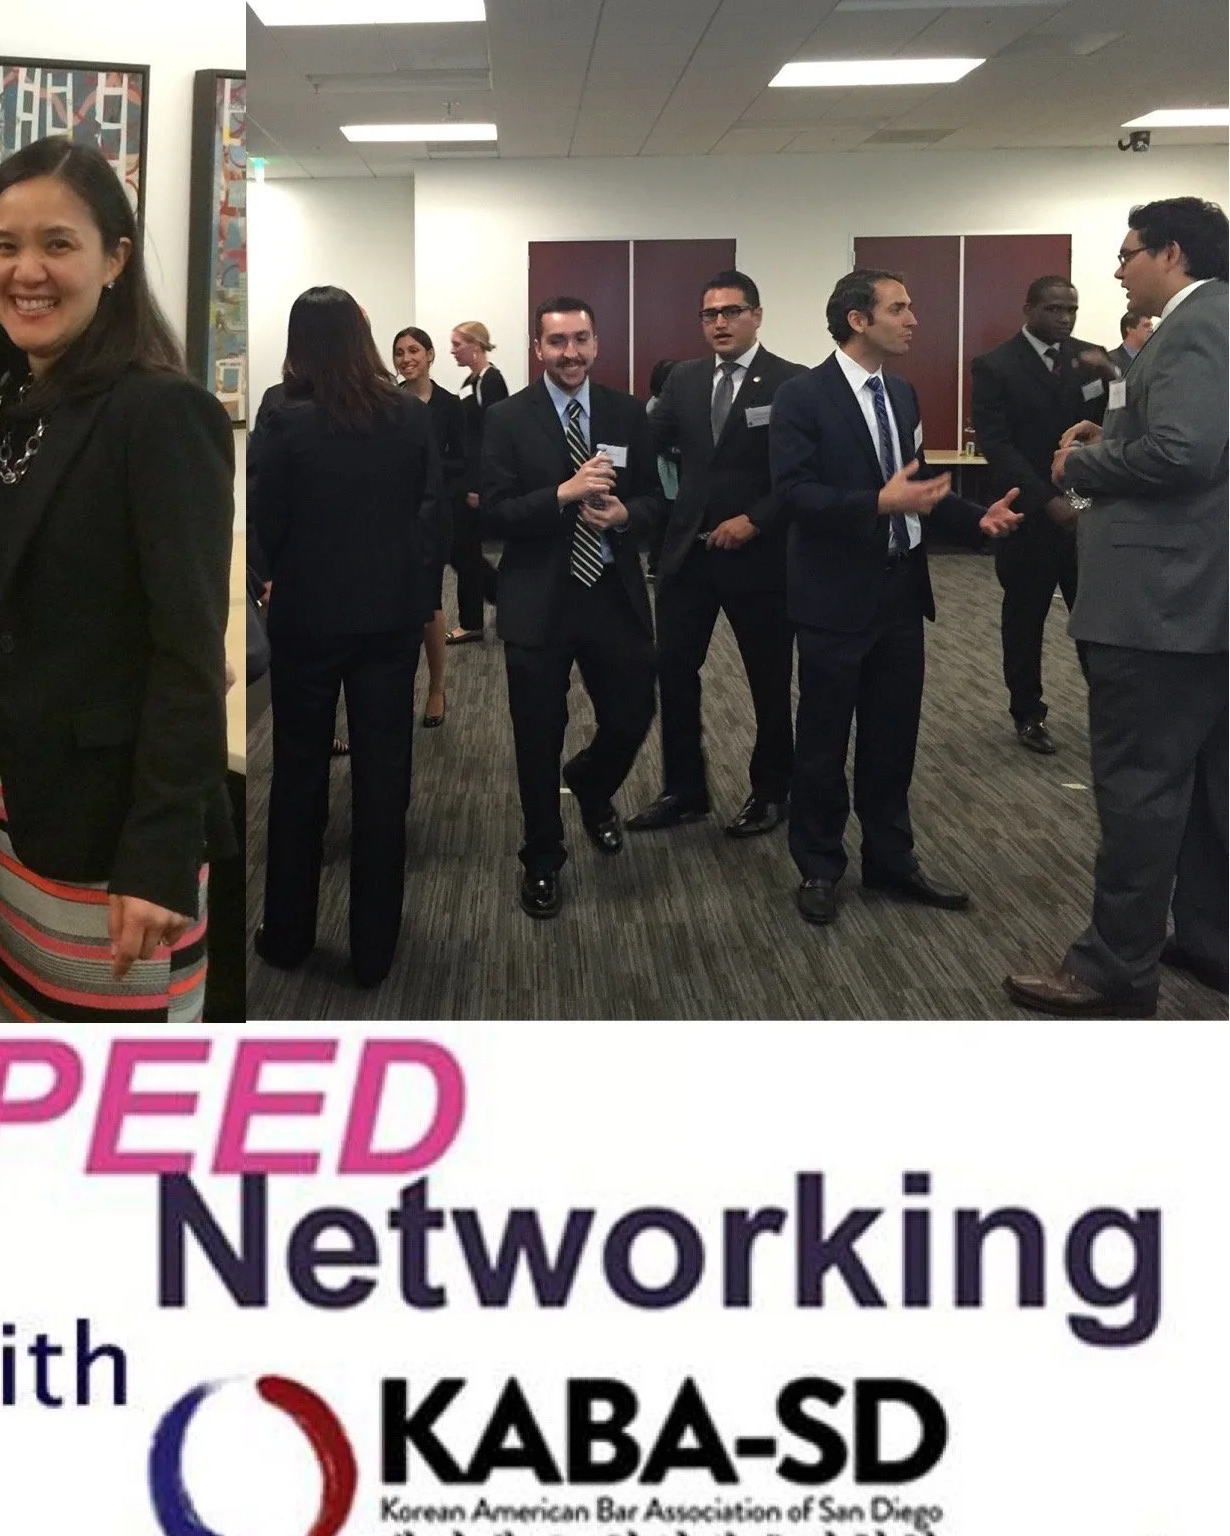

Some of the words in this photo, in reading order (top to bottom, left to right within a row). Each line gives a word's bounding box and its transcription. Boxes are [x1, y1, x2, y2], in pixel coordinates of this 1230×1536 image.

[158, 1170, 1162, 1348] Networking
[381, 1376, 950, 1487] KABA-SD
[381, 1496, 466, 1523] Korean
[470, 1497, 590, 1523] American
[596, 1495, 638, 1523] Bar
[643, 1497, 783, 1523] Association
[787, 1496, 815, 1523] of
[818, 1496, 866, 1524] San
[870, 1496, 944, 1530] Diego
